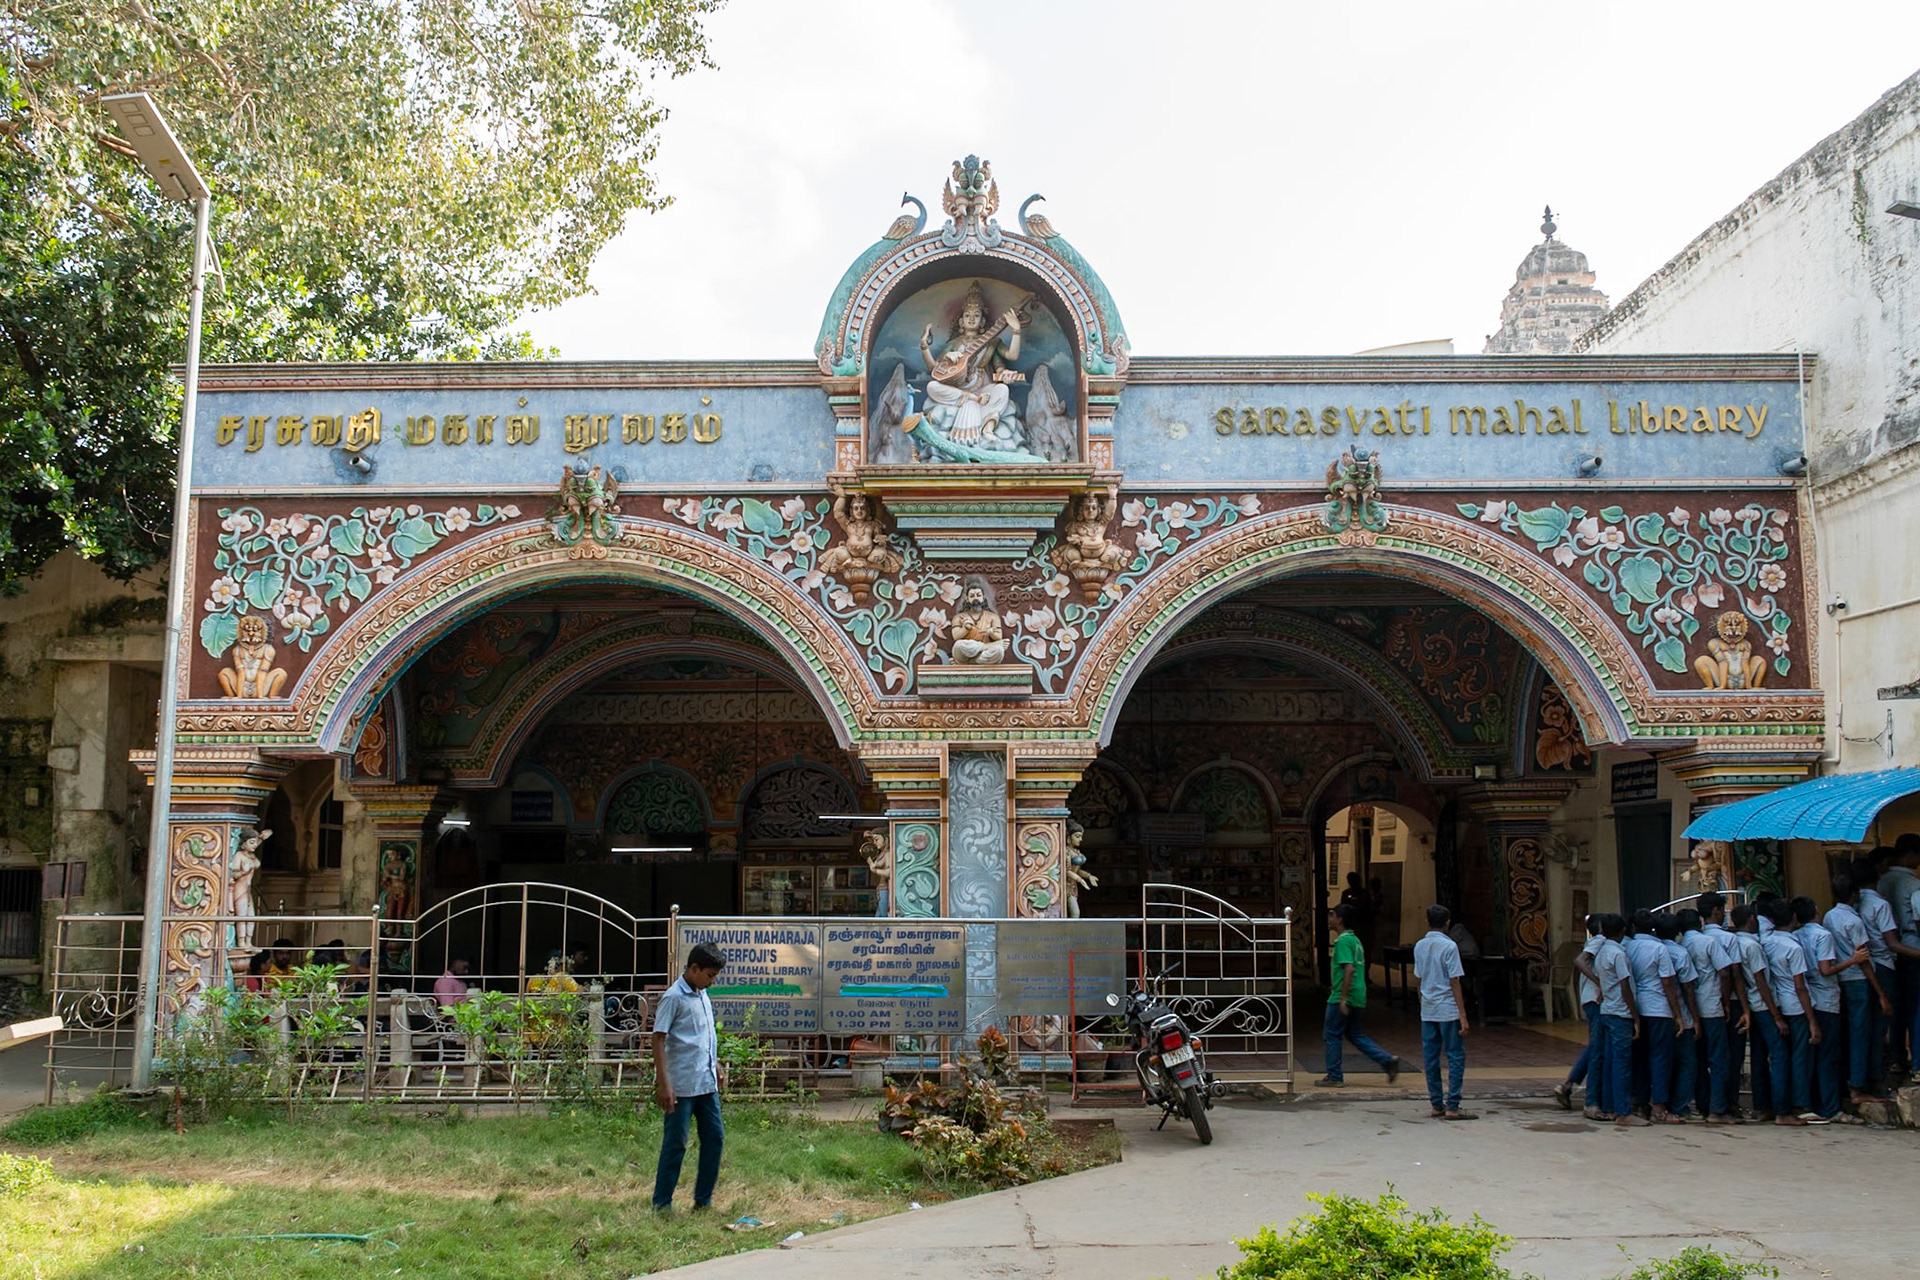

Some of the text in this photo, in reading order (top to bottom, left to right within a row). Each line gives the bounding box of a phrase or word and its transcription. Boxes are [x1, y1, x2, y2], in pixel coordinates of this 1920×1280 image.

[406, 396, 539, 445] மகால்
[563, 395, 722, 453] நூலகம்
[684, 930, 815, 945] THANJAVUR MAHARAJA
[828, 928, 960, 944] தஞ்சாவூர் மகாராஜா
[852, 943, 935, 956] சரபோஜியின்
[827, 957, 960, 972] சரசுவதி மகால் நூலகம்
[737, 965, 770, 975] MAHAL
[773, 966, 813, 976] LIBRARY
[713, 976, 784, 986] MUSEUM
[711, 1001, 791, 1009] ORKING HOURS
[761, 1009, 789, 1017] 1.00
[794, 1009, 816, 1017] PM
[828, 1010, 865, 1018] 10.00
[869, 1010, 891, 1018] AM
[905, 1010, 933, 1018] 1.00
[938, 1010, 959, 1018] PM
[759, 1020, 789, 1028] 5.30
[794, 1020, 816, 1028] PM
[837, 1020, 865, 1028] 1.30
[904, 1020, 933, 1028] 5.30
[938, 1020, 959, 1028] PM
